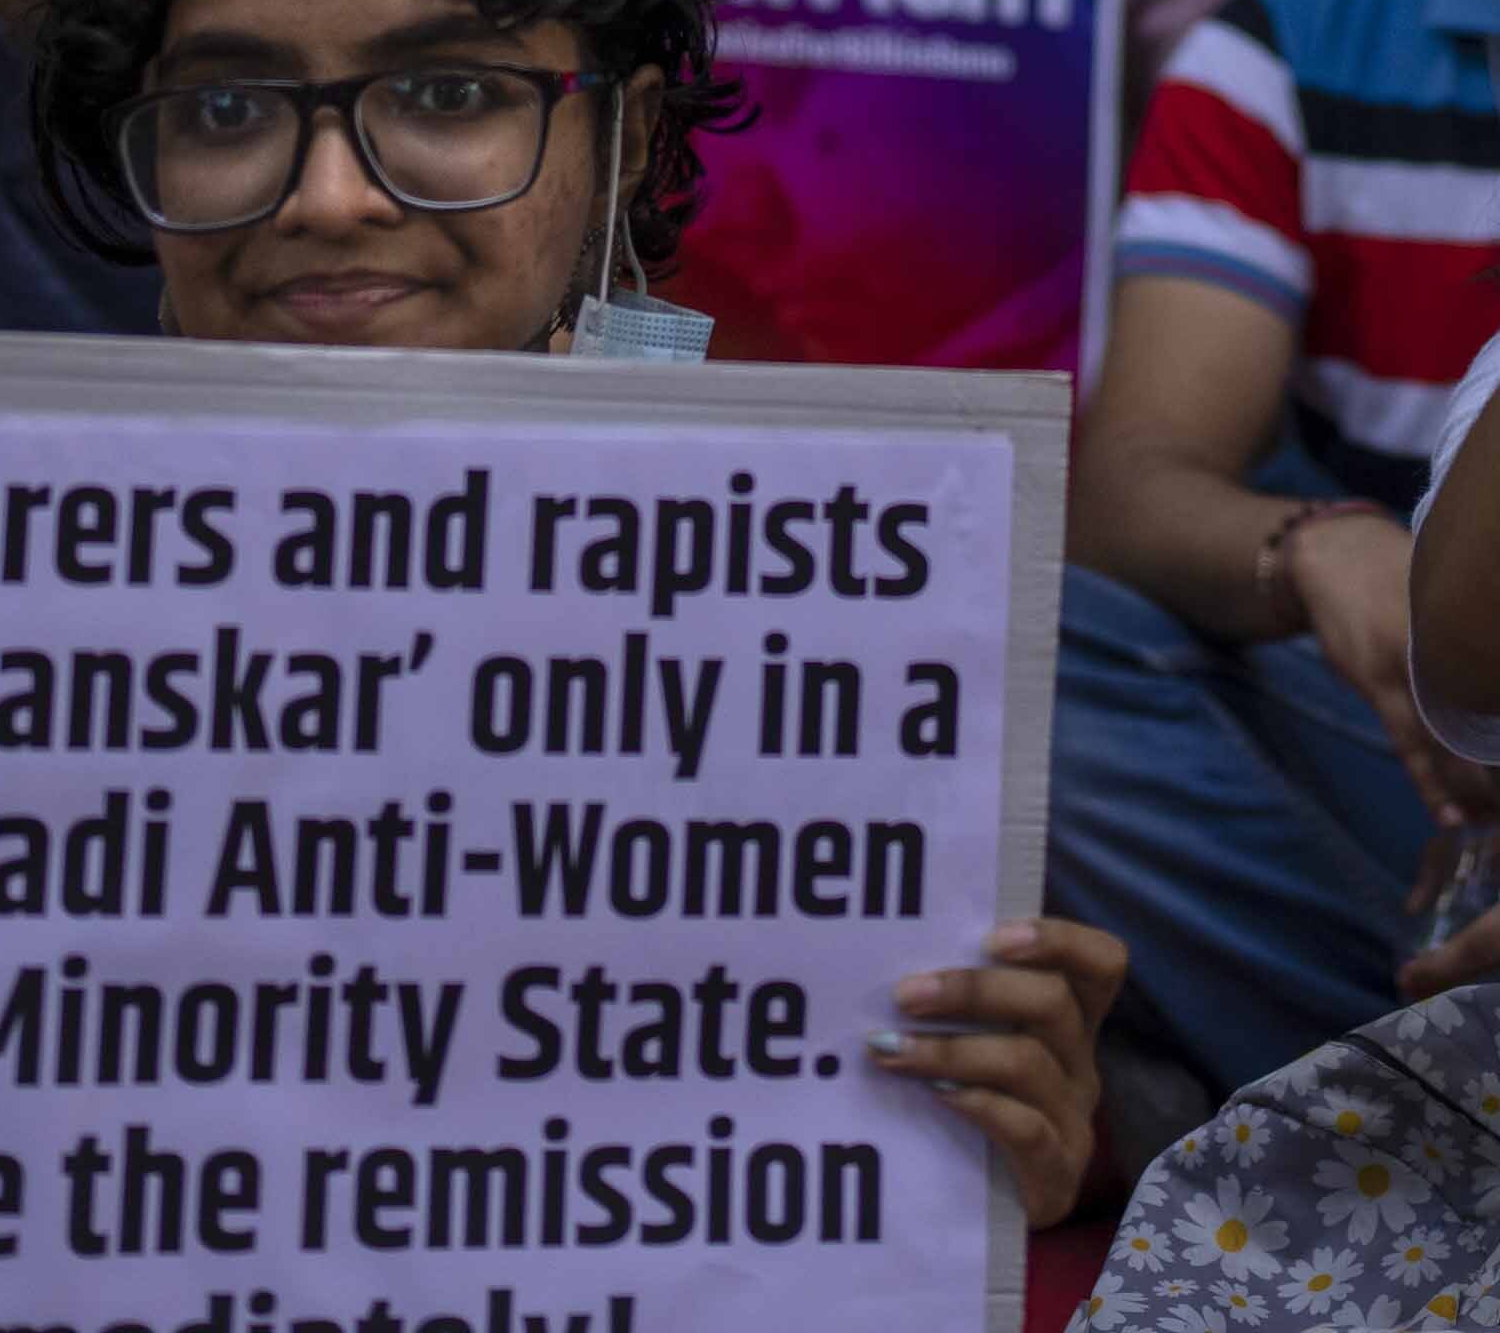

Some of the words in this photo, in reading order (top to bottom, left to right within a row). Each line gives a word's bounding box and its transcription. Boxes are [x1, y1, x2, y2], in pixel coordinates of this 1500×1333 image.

[274, 469, 489, 590] and
[531, 472, 928, 617] rapists
[471, 633, 723, 779] only
[760, 632, 861, 756] in
[900, 662, 959, 757] a
[206, 791, 924, 919] Anti-Women
[498, 965, 840, 1081] State.
[63, 1125, 261, 1257] the
[302, 1116, 880, 1250] remission
